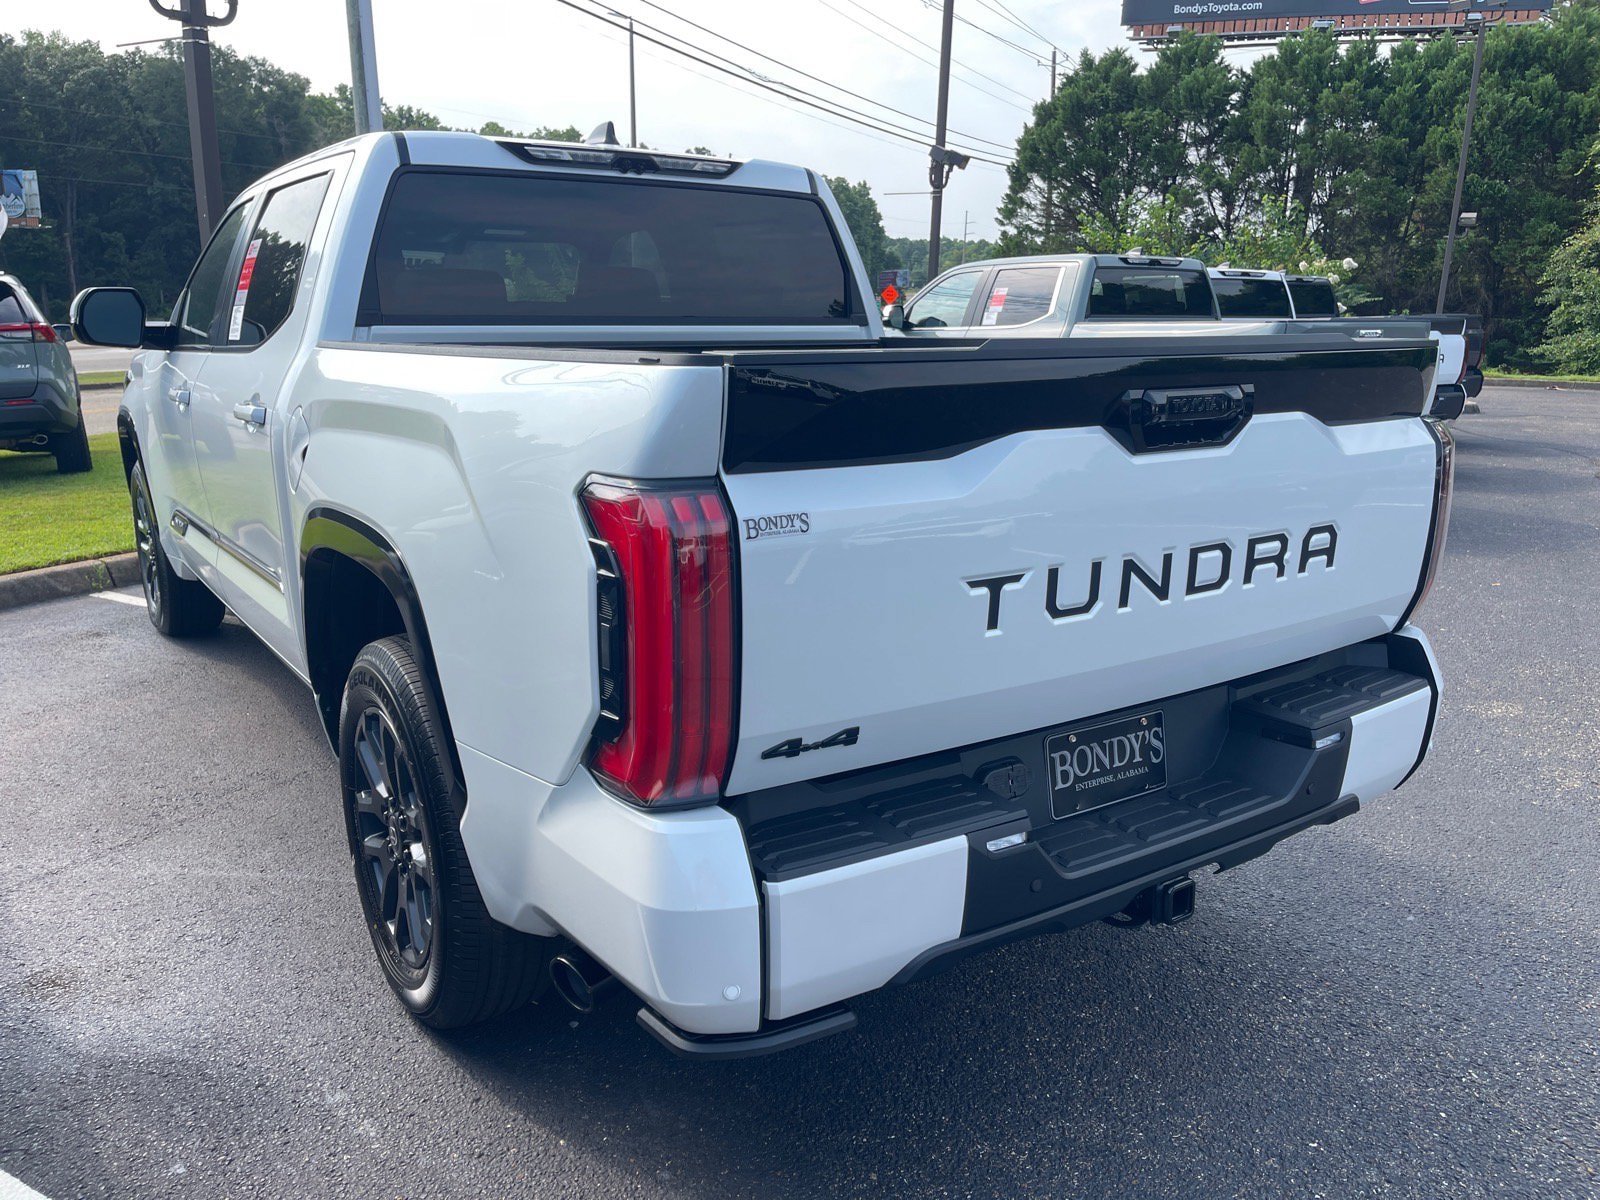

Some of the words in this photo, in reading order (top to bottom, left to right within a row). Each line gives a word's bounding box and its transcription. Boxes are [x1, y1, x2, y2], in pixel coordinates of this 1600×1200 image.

[1173, 2, 1263, 15] BondysToyota.com
[1172, 396, 1219, 412] TOYOTA
[743, 512, 809, 540] BONDY'S
[963, 521, 1339, 632] TUNDRA
[1050, 727, 1164, 790] BONDY'S
[1075, 774, 1116, 791] ENTERPRISE,
[1117, 766, 1149, 780] ALABAMA
